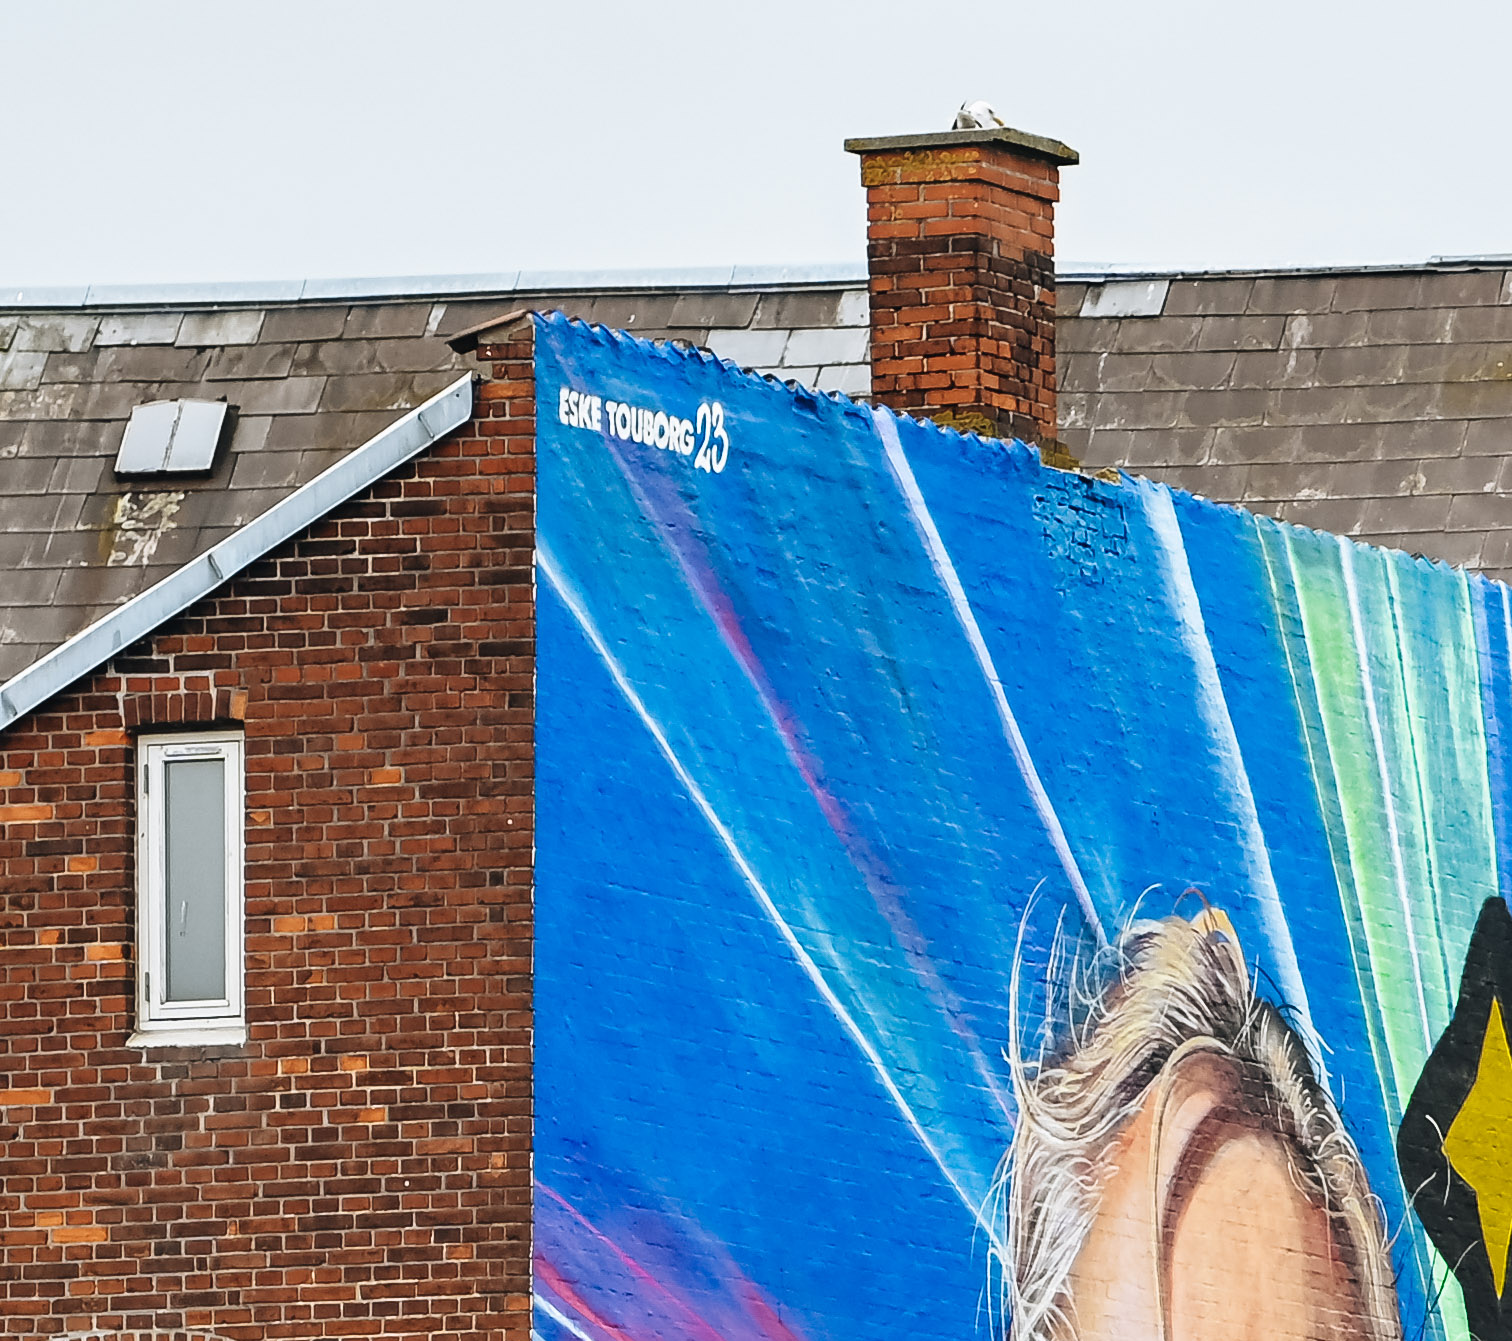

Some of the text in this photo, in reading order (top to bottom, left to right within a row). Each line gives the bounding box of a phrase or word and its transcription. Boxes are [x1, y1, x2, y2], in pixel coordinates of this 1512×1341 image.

[559, 387, 729, 473] ESKE TOUBORG 23
